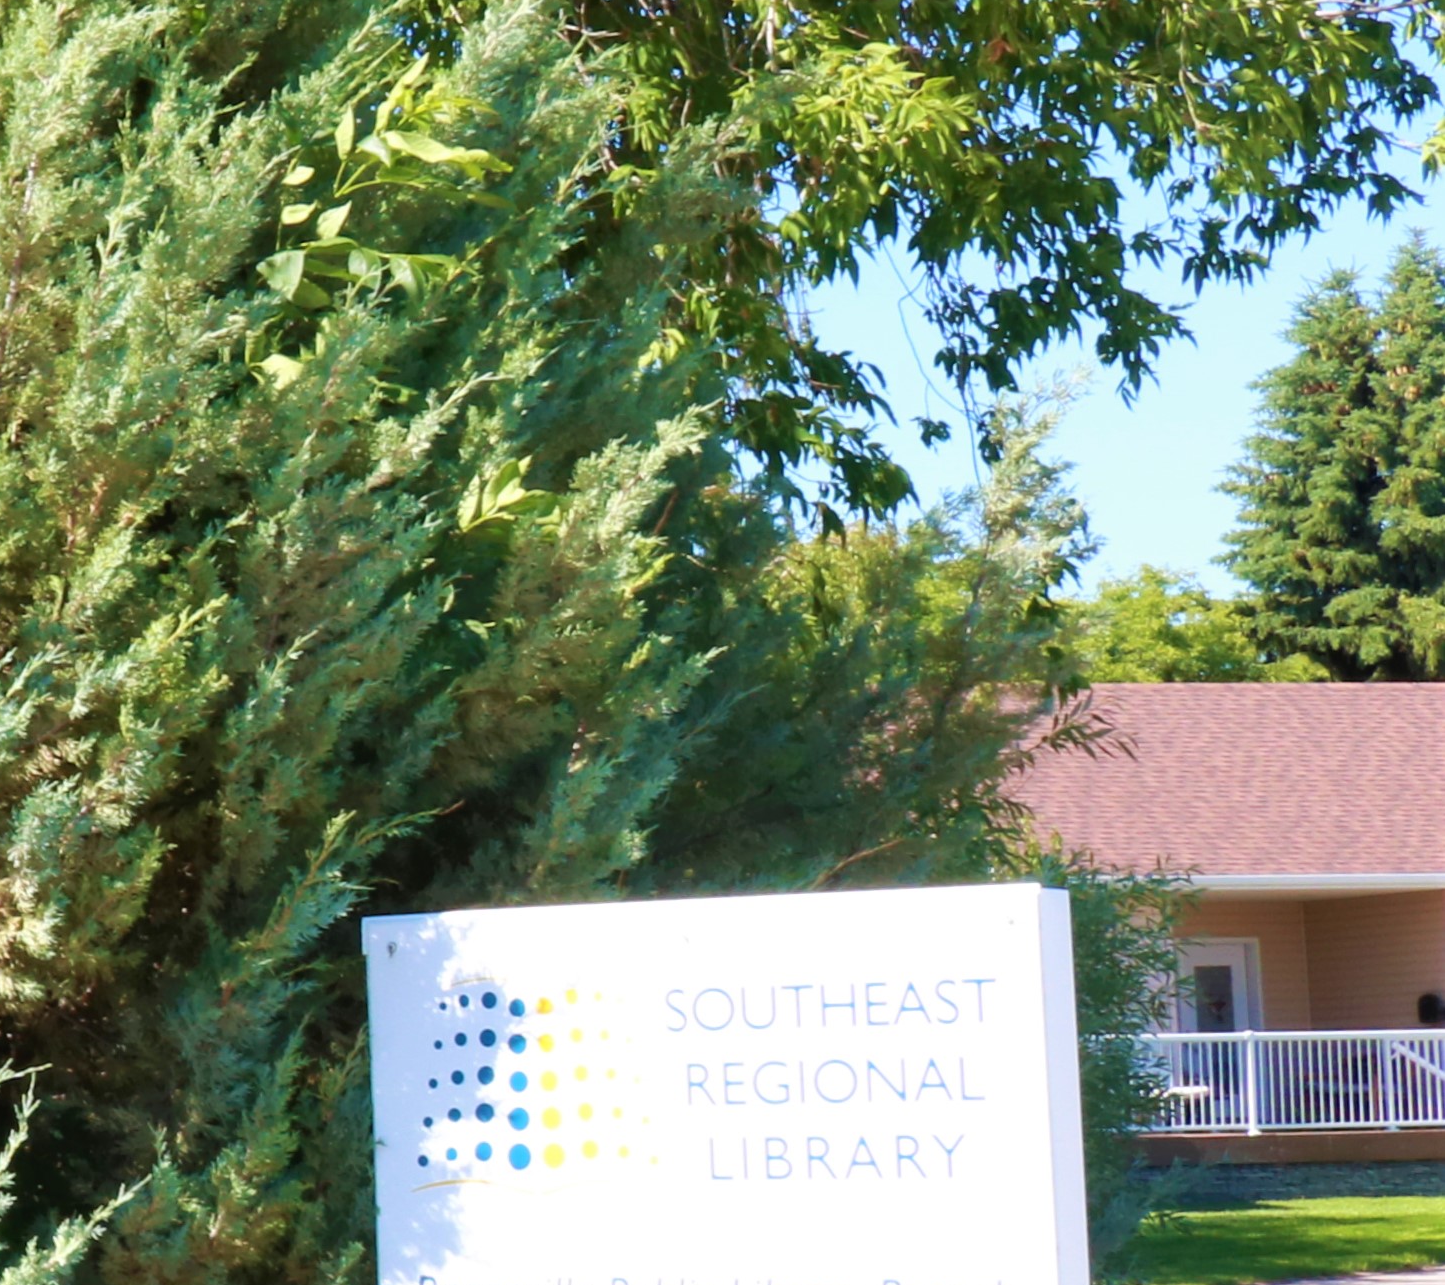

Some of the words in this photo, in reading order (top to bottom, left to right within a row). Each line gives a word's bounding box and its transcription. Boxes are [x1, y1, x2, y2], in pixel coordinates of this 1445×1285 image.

[665, 978, 996, 1032] SOUTHEAST
[686, 1057, 986, 1105] REGIONAL
[709, 1134, 964, 1180] LIBRARY
